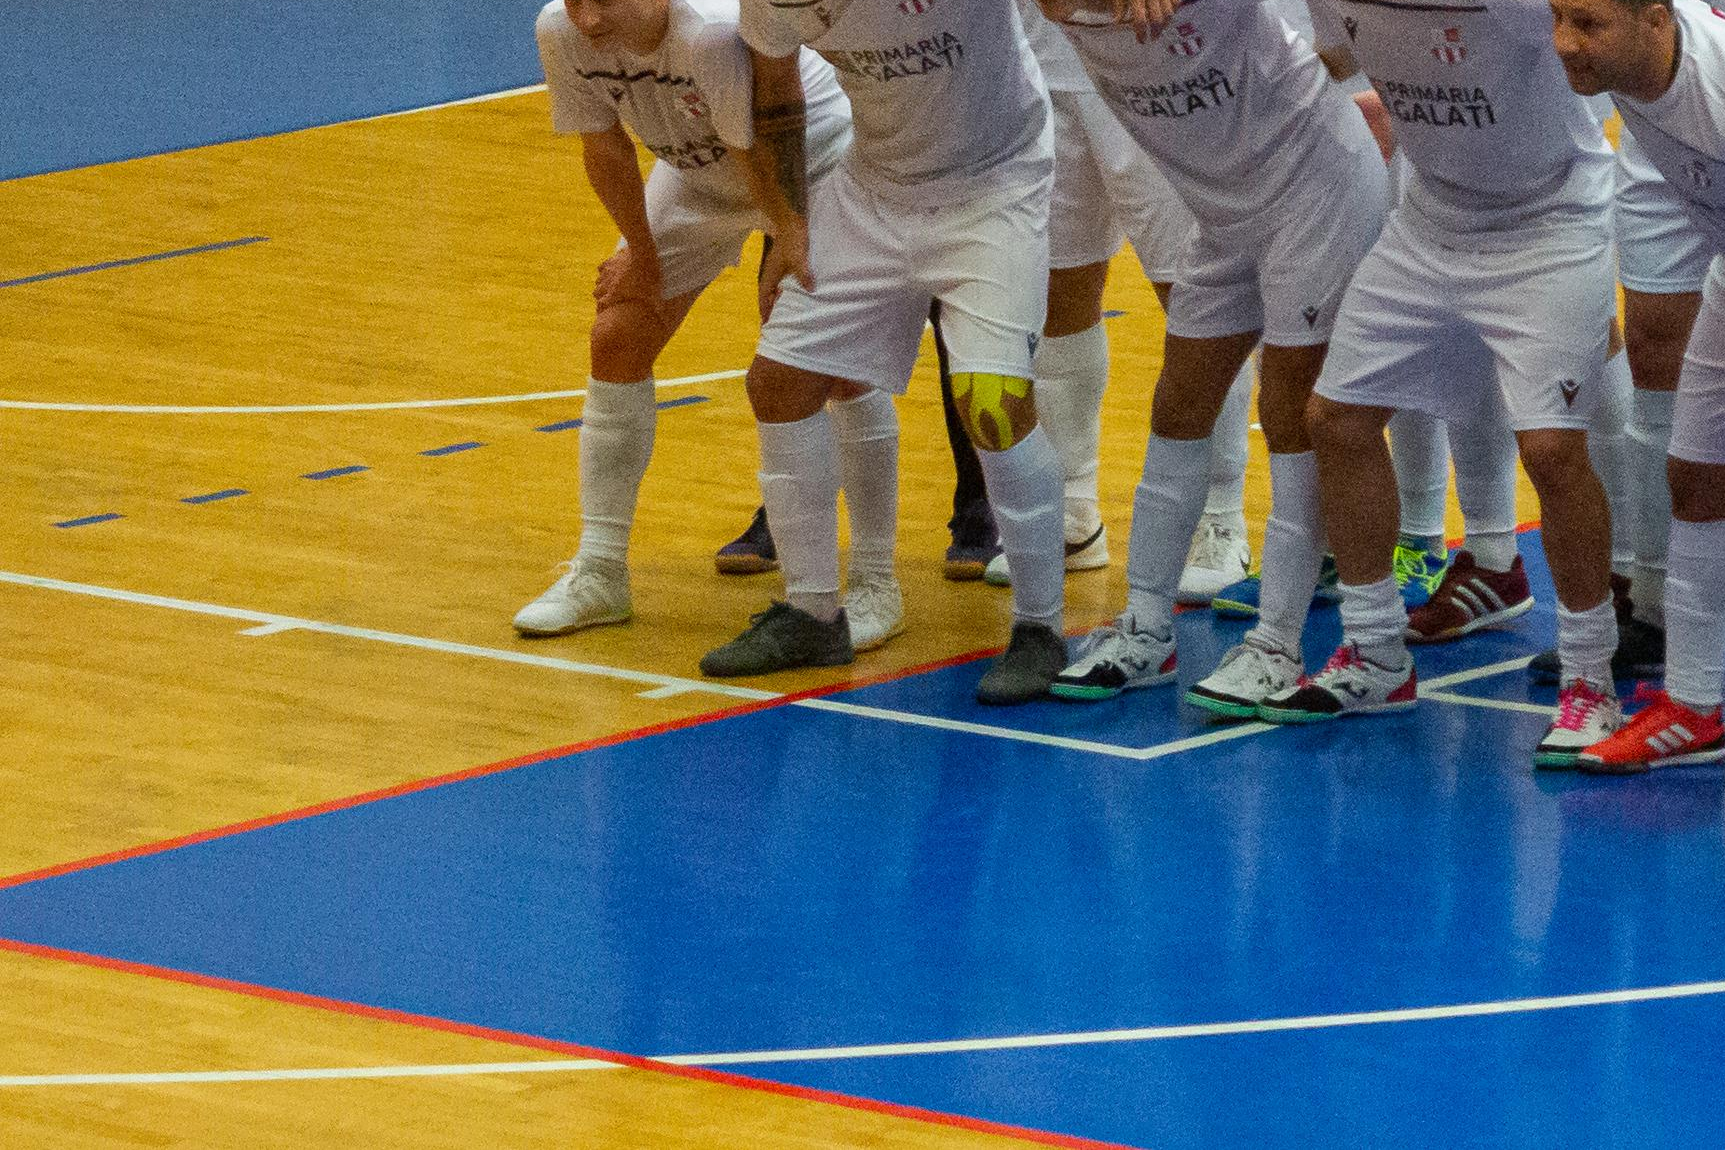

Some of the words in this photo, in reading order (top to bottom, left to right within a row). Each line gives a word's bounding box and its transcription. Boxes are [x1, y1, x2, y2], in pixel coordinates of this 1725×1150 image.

[850, 31, 960, 65] PRIMARIA
[1129, 77, 1235, 118] GALATI
[1385, 81, 1489, 104] PRIMARIA
[1393, 100, 1497, 129] GALATI
